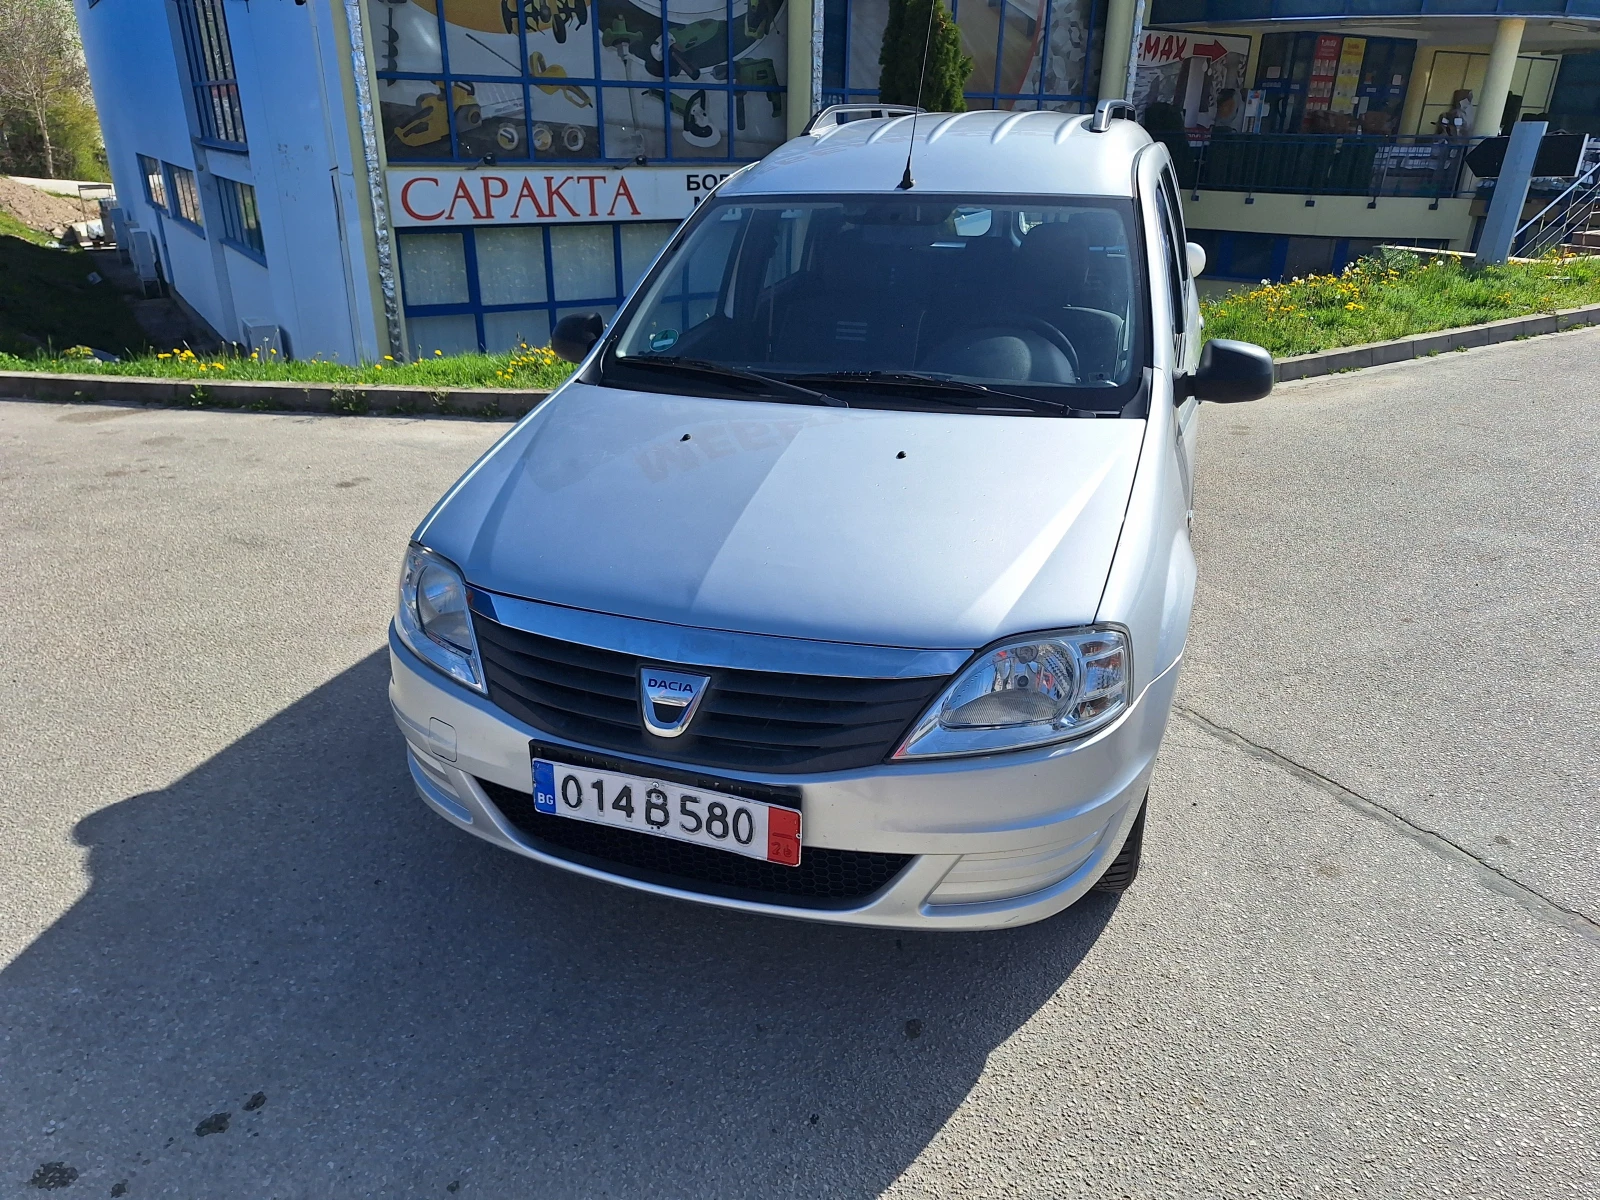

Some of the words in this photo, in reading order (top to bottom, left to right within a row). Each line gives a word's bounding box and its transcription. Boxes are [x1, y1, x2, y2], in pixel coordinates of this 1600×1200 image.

[401, 175, 641, 220] САРАКТА
[647, 678, 694, 693] DACIA
[537, 791, 554, 805] BG
